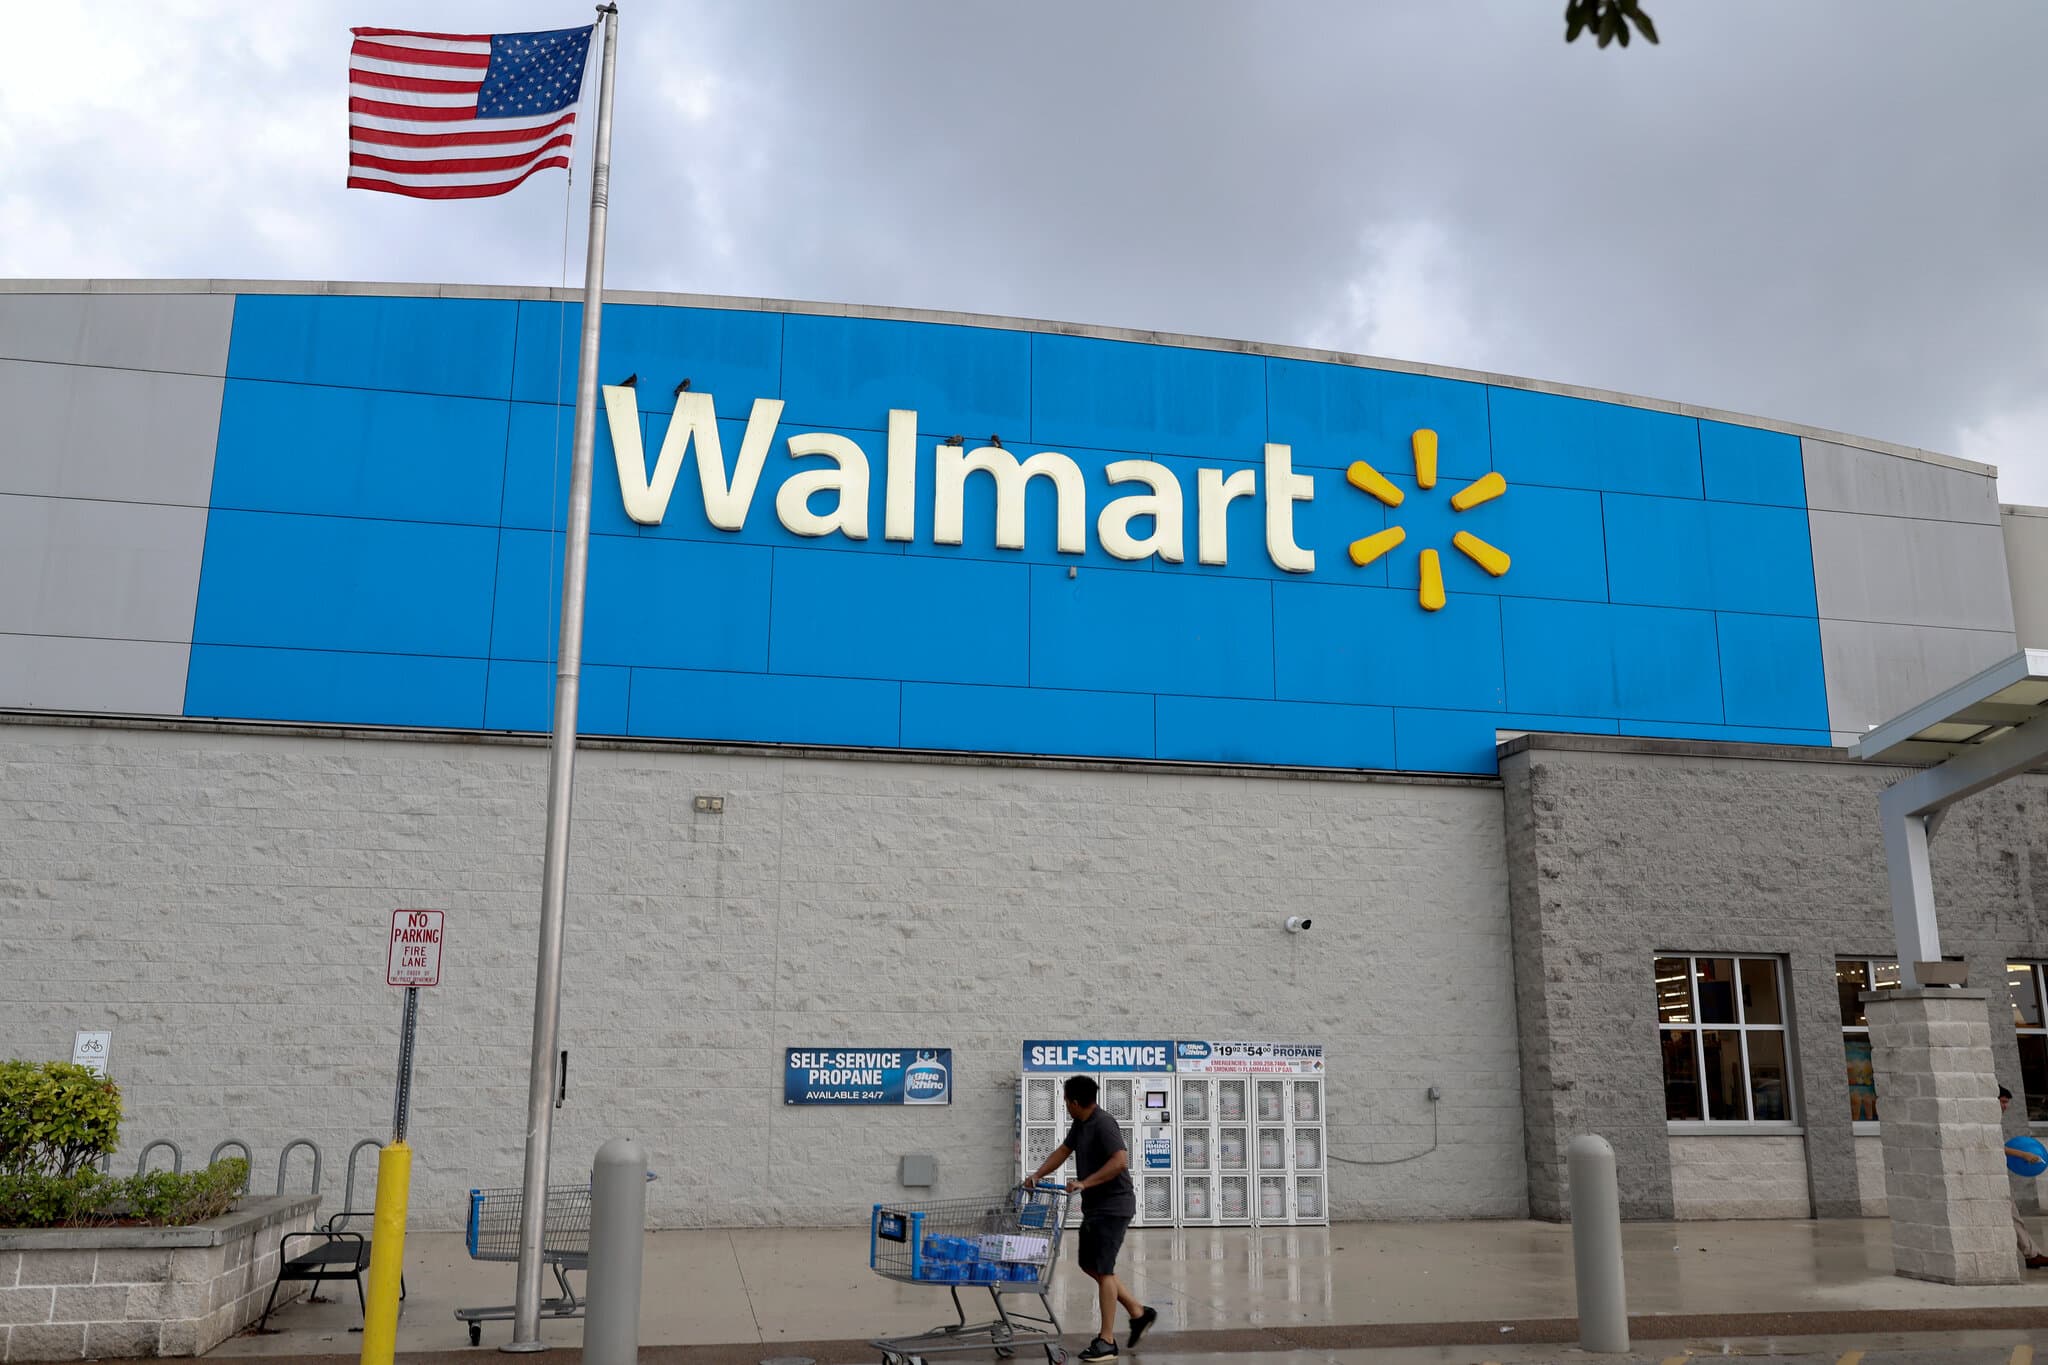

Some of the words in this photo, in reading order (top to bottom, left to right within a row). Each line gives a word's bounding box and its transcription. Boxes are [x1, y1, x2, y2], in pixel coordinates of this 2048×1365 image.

[602, 384, 1316, 574] Walmart
[408, 913, 428, 928] NO
[394, 928, 439, 944] PARKING
[404, 946, 427, 957] FIRE
[401, 957, 428, 968] LANE
[1031, 1046, 1166, 1066] SELF-SERVICE
[1273, 1048, 1323, 1057] PROPANE
[790, 1052, 901, 1069] SELF-SERVICE
[809, 1069, 882, 1086] PROPANE
[806, 1091, 859, 1100] AVAILABLE
[862, 1091, 884, 1100] 24/7
